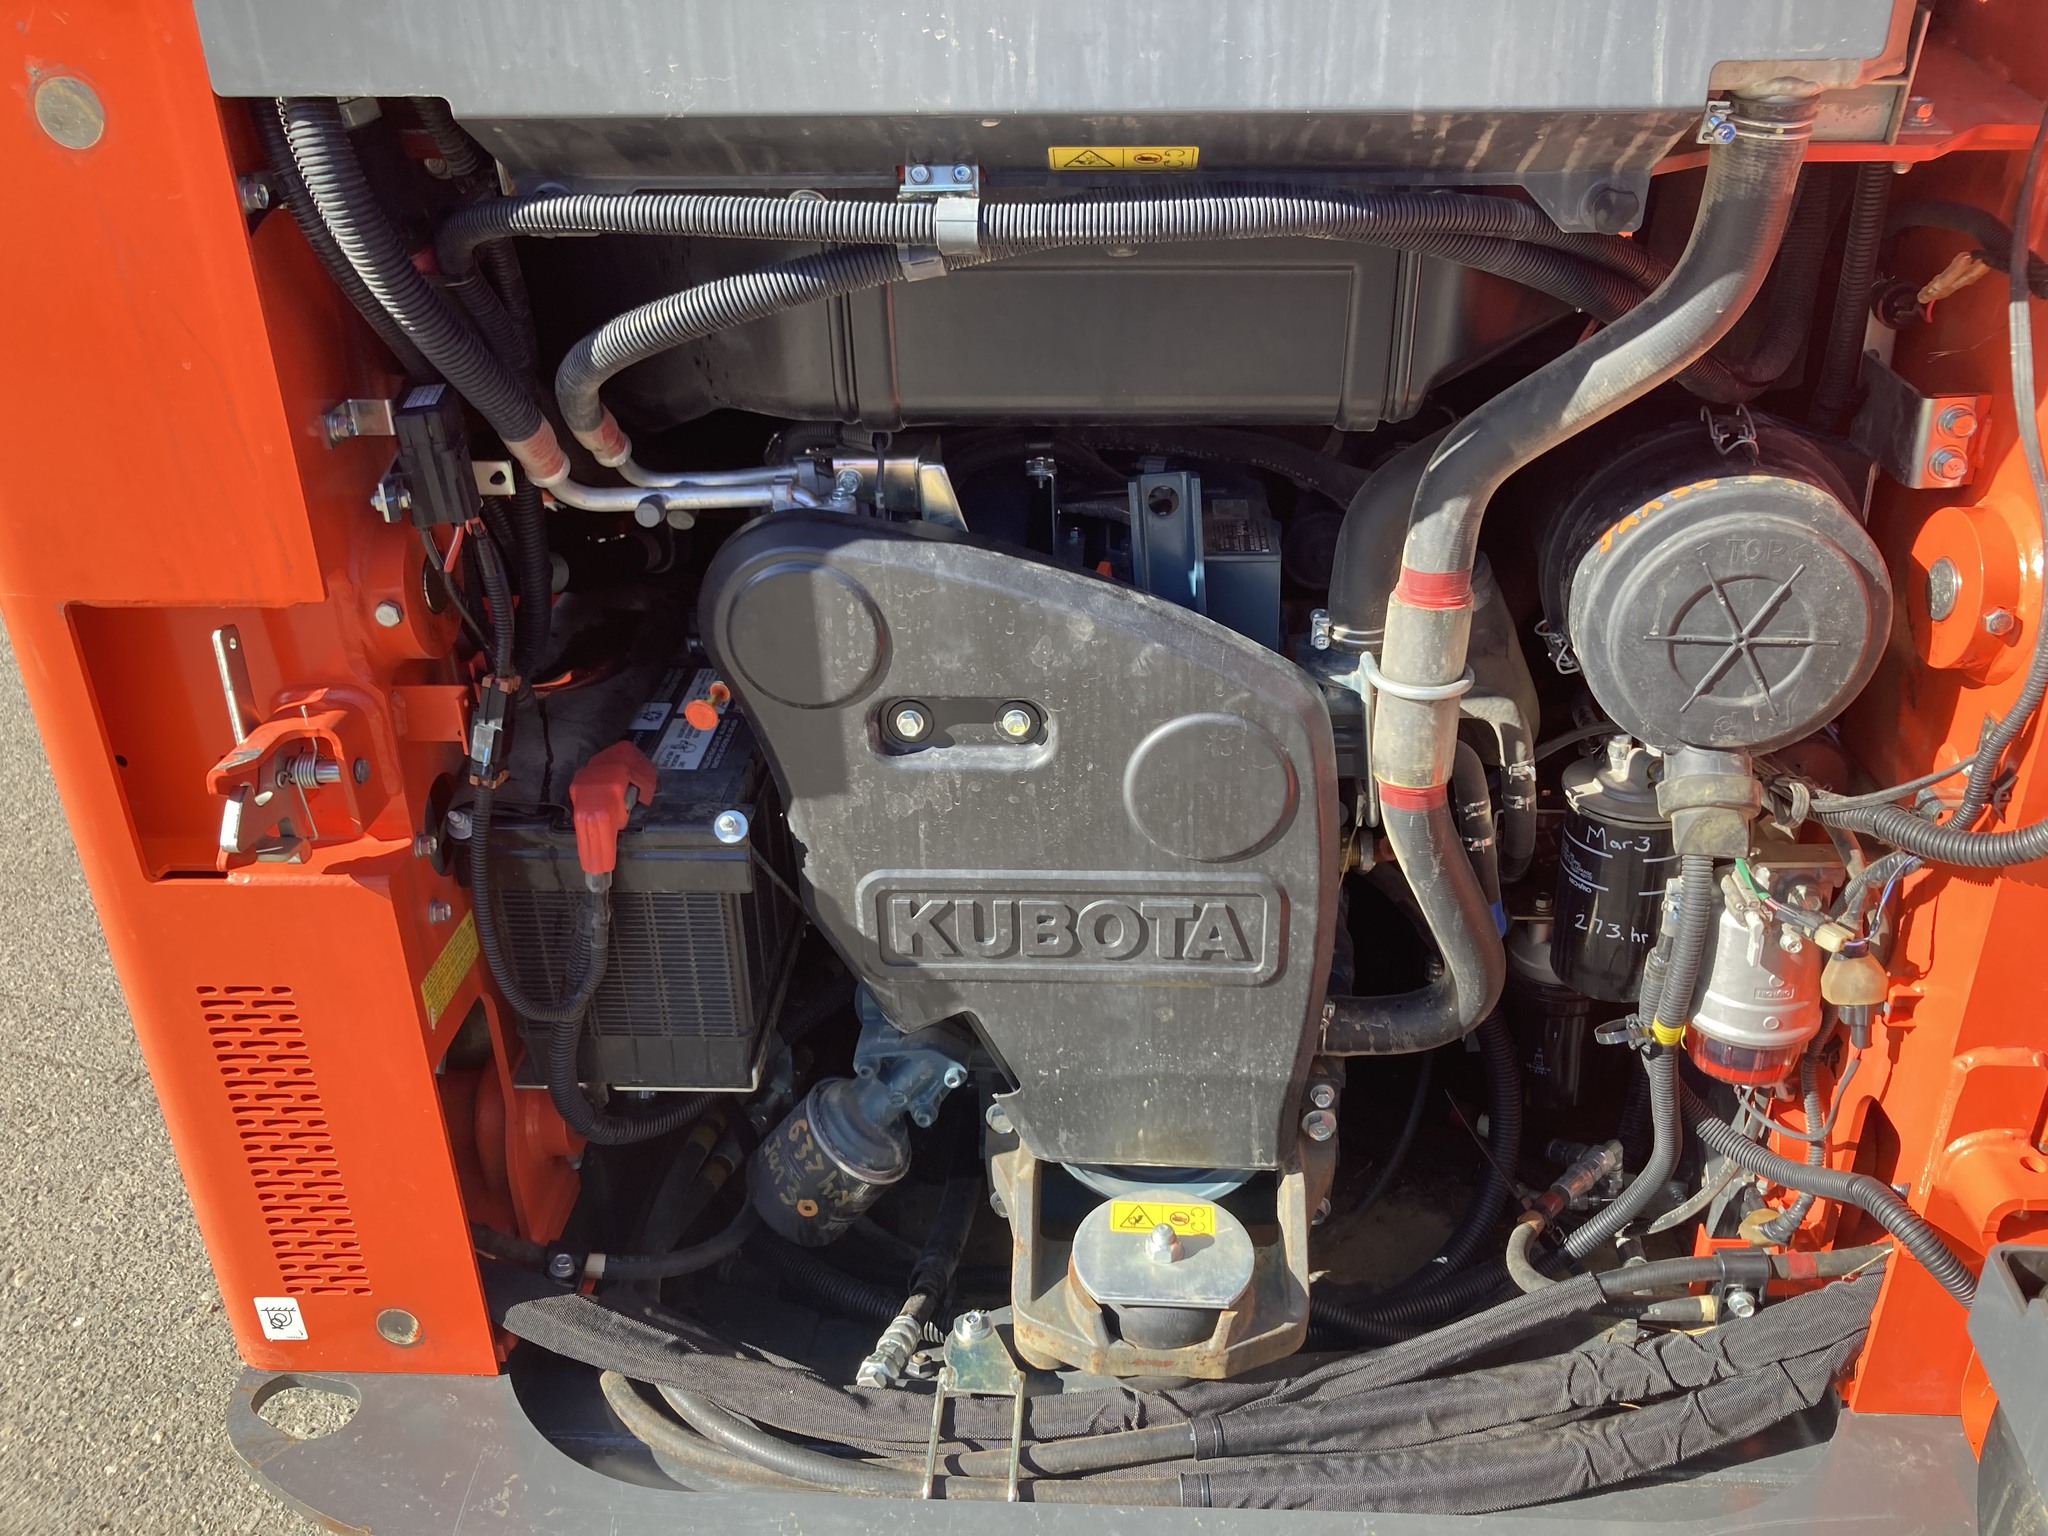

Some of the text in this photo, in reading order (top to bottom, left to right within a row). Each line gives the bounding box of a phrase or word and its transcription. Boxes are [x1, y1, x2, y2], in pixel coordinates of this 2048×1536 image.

[1726, 538, 1787, 563] TOP
[1586, 825, 1633, 850] Mar
[1633, 836, 1651, 852] 3
[891, 898, 1254, 961] KUBOTA
[1630, 926, 1649, 944] hr
[788, 1119, 825, 1171] 637
